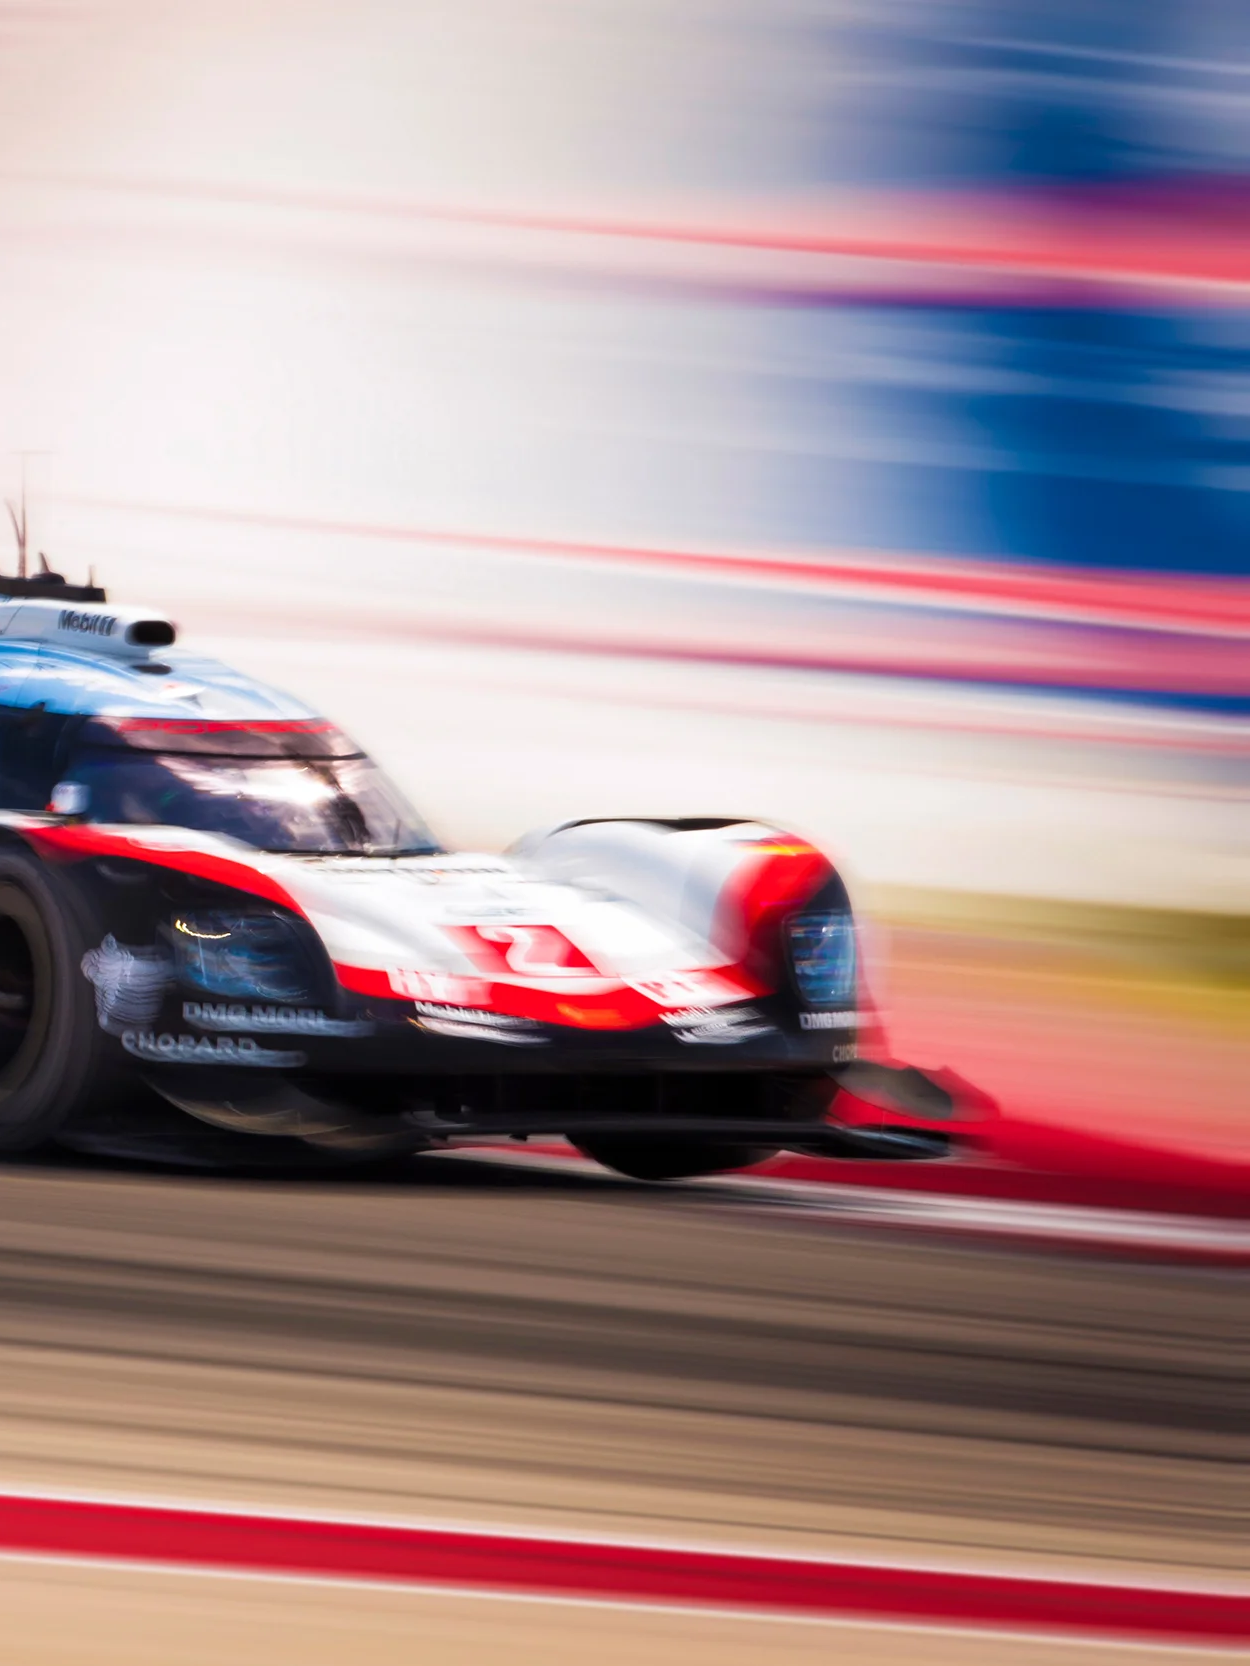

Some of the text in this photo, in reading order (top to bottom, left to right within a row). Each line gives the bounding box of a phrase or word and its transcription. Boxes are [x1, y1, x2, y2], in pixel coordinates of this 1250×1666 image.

[472, 926, 600, 977] 2
[182, 1001, 248, 1024] DMG
[120, 1030, 261, 1056] CHOPARD
